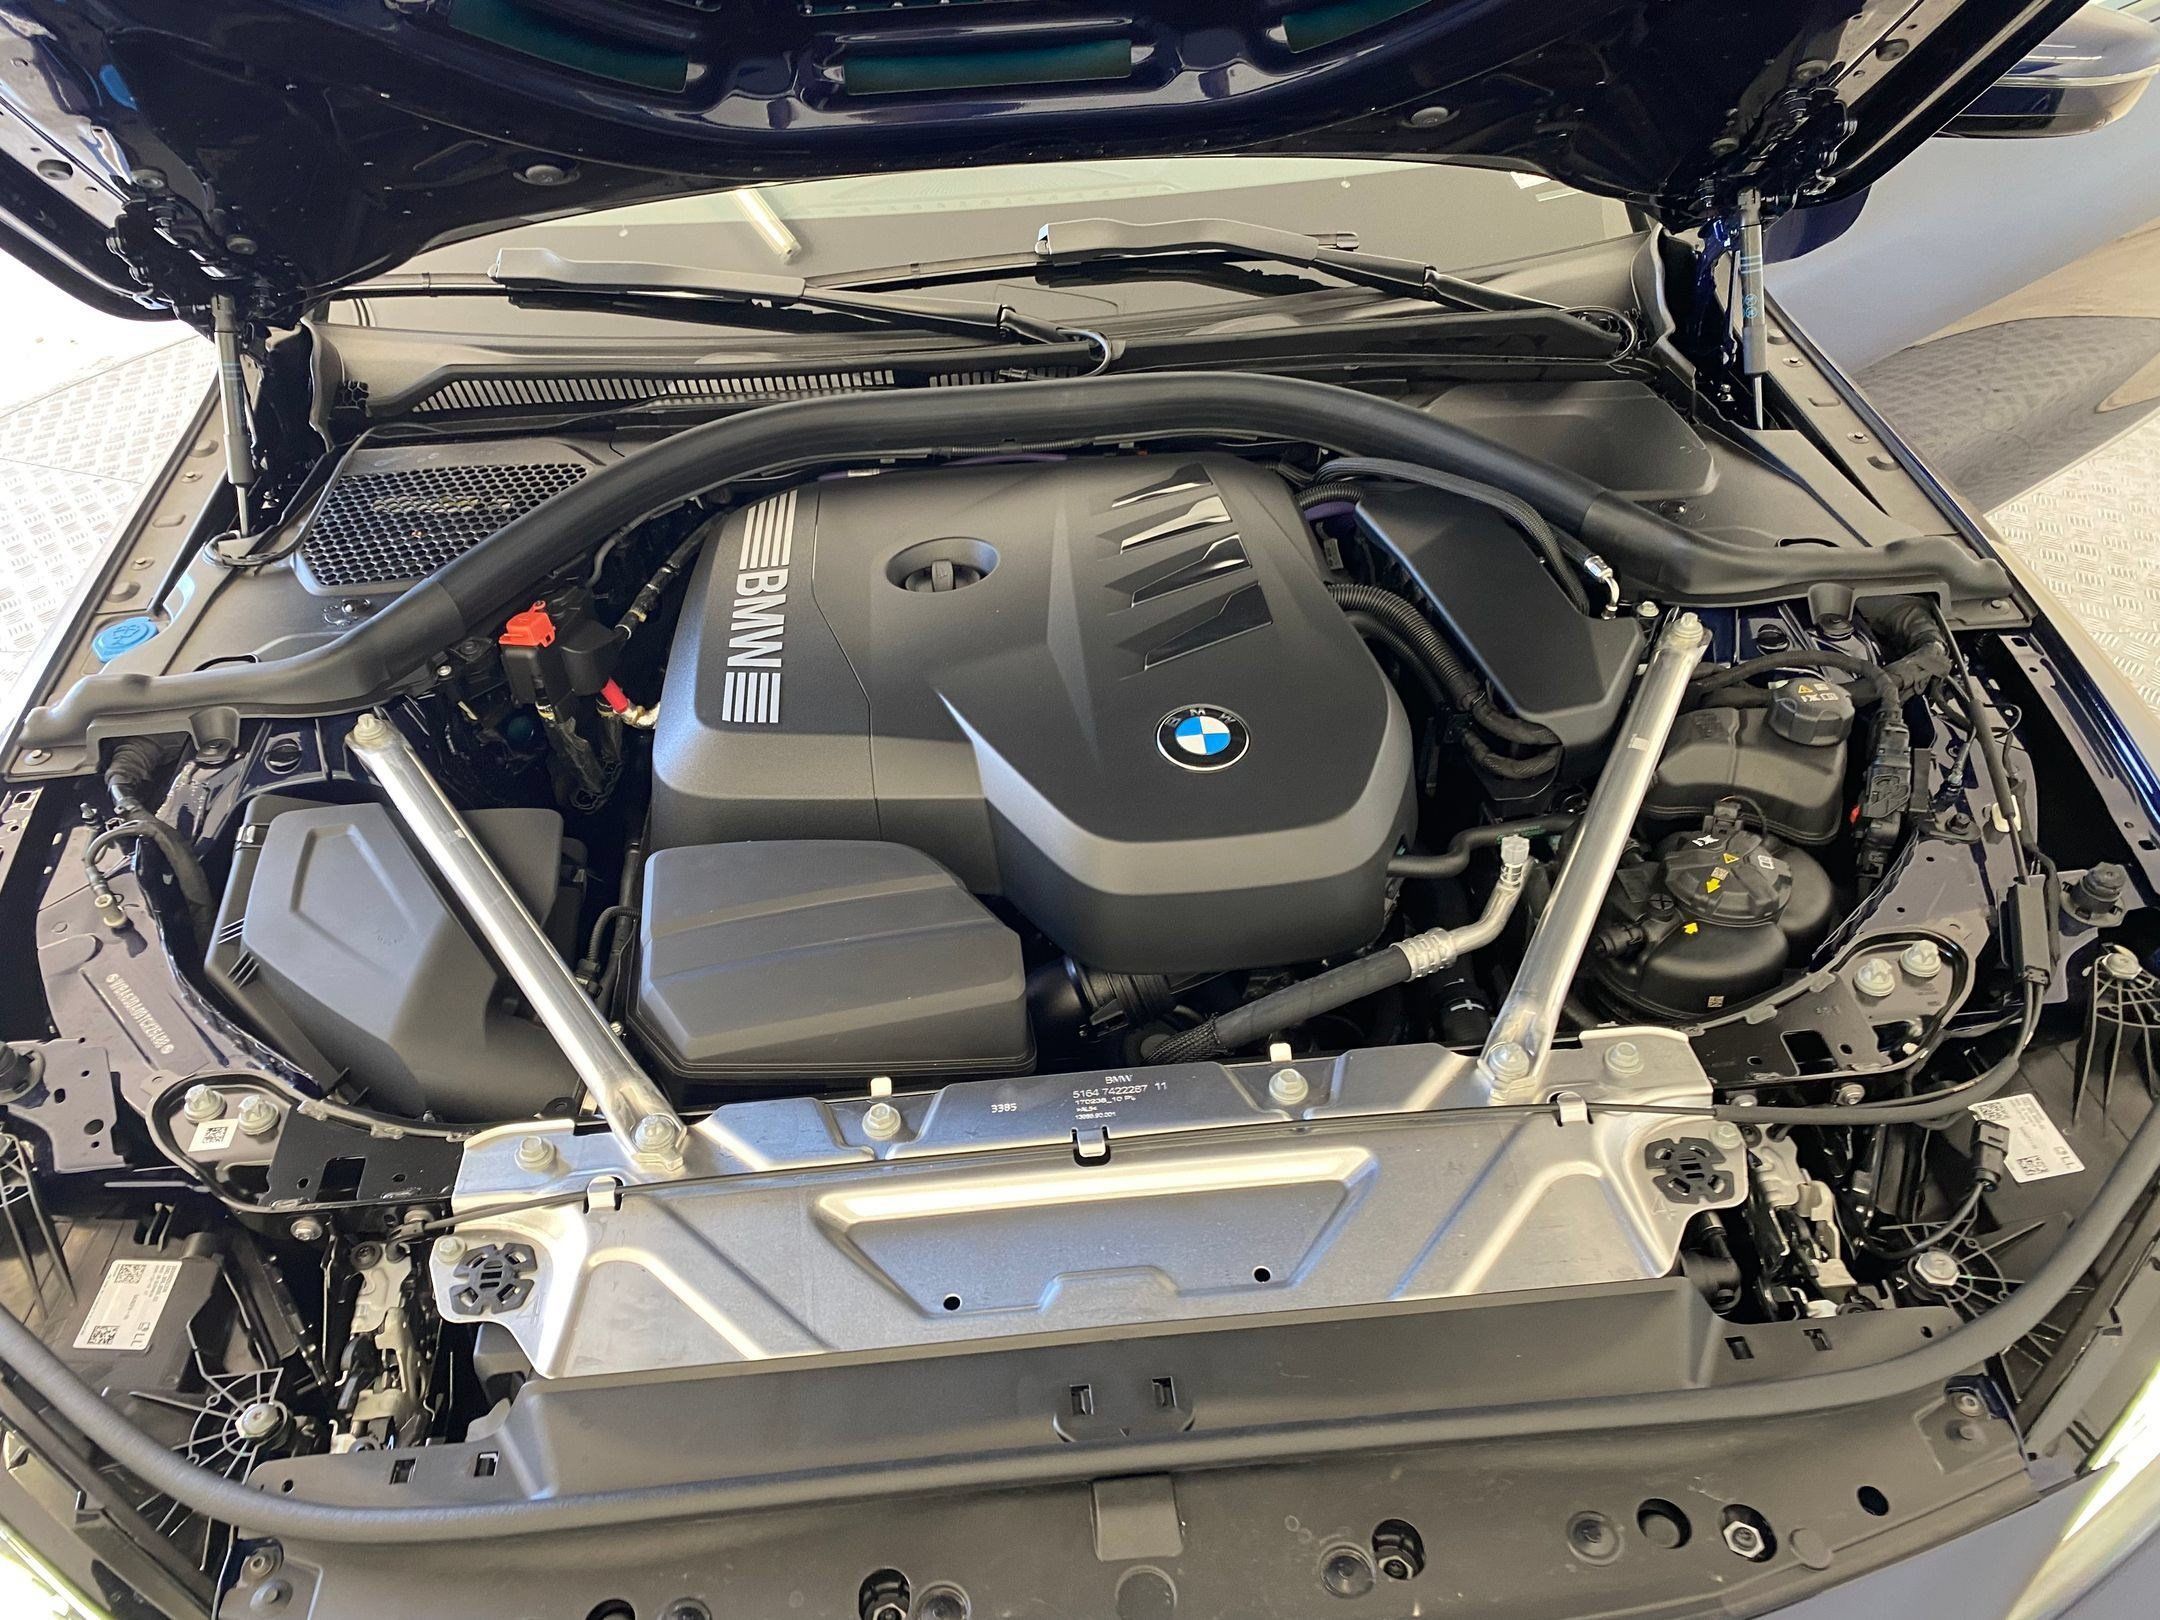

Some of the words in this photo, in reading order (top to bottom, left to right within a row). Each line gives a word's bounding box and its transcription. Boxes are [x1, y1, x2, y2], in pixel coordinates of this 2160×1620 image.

[727, 568, 789, 668] BMW
[1105, 1074, 1133, 1084] BMW
[1072, 1088, 1100, 1099] 5164
[1154, 1081, 1168, 1091] 11
[991, 1102, 1018, 1114] 3385
